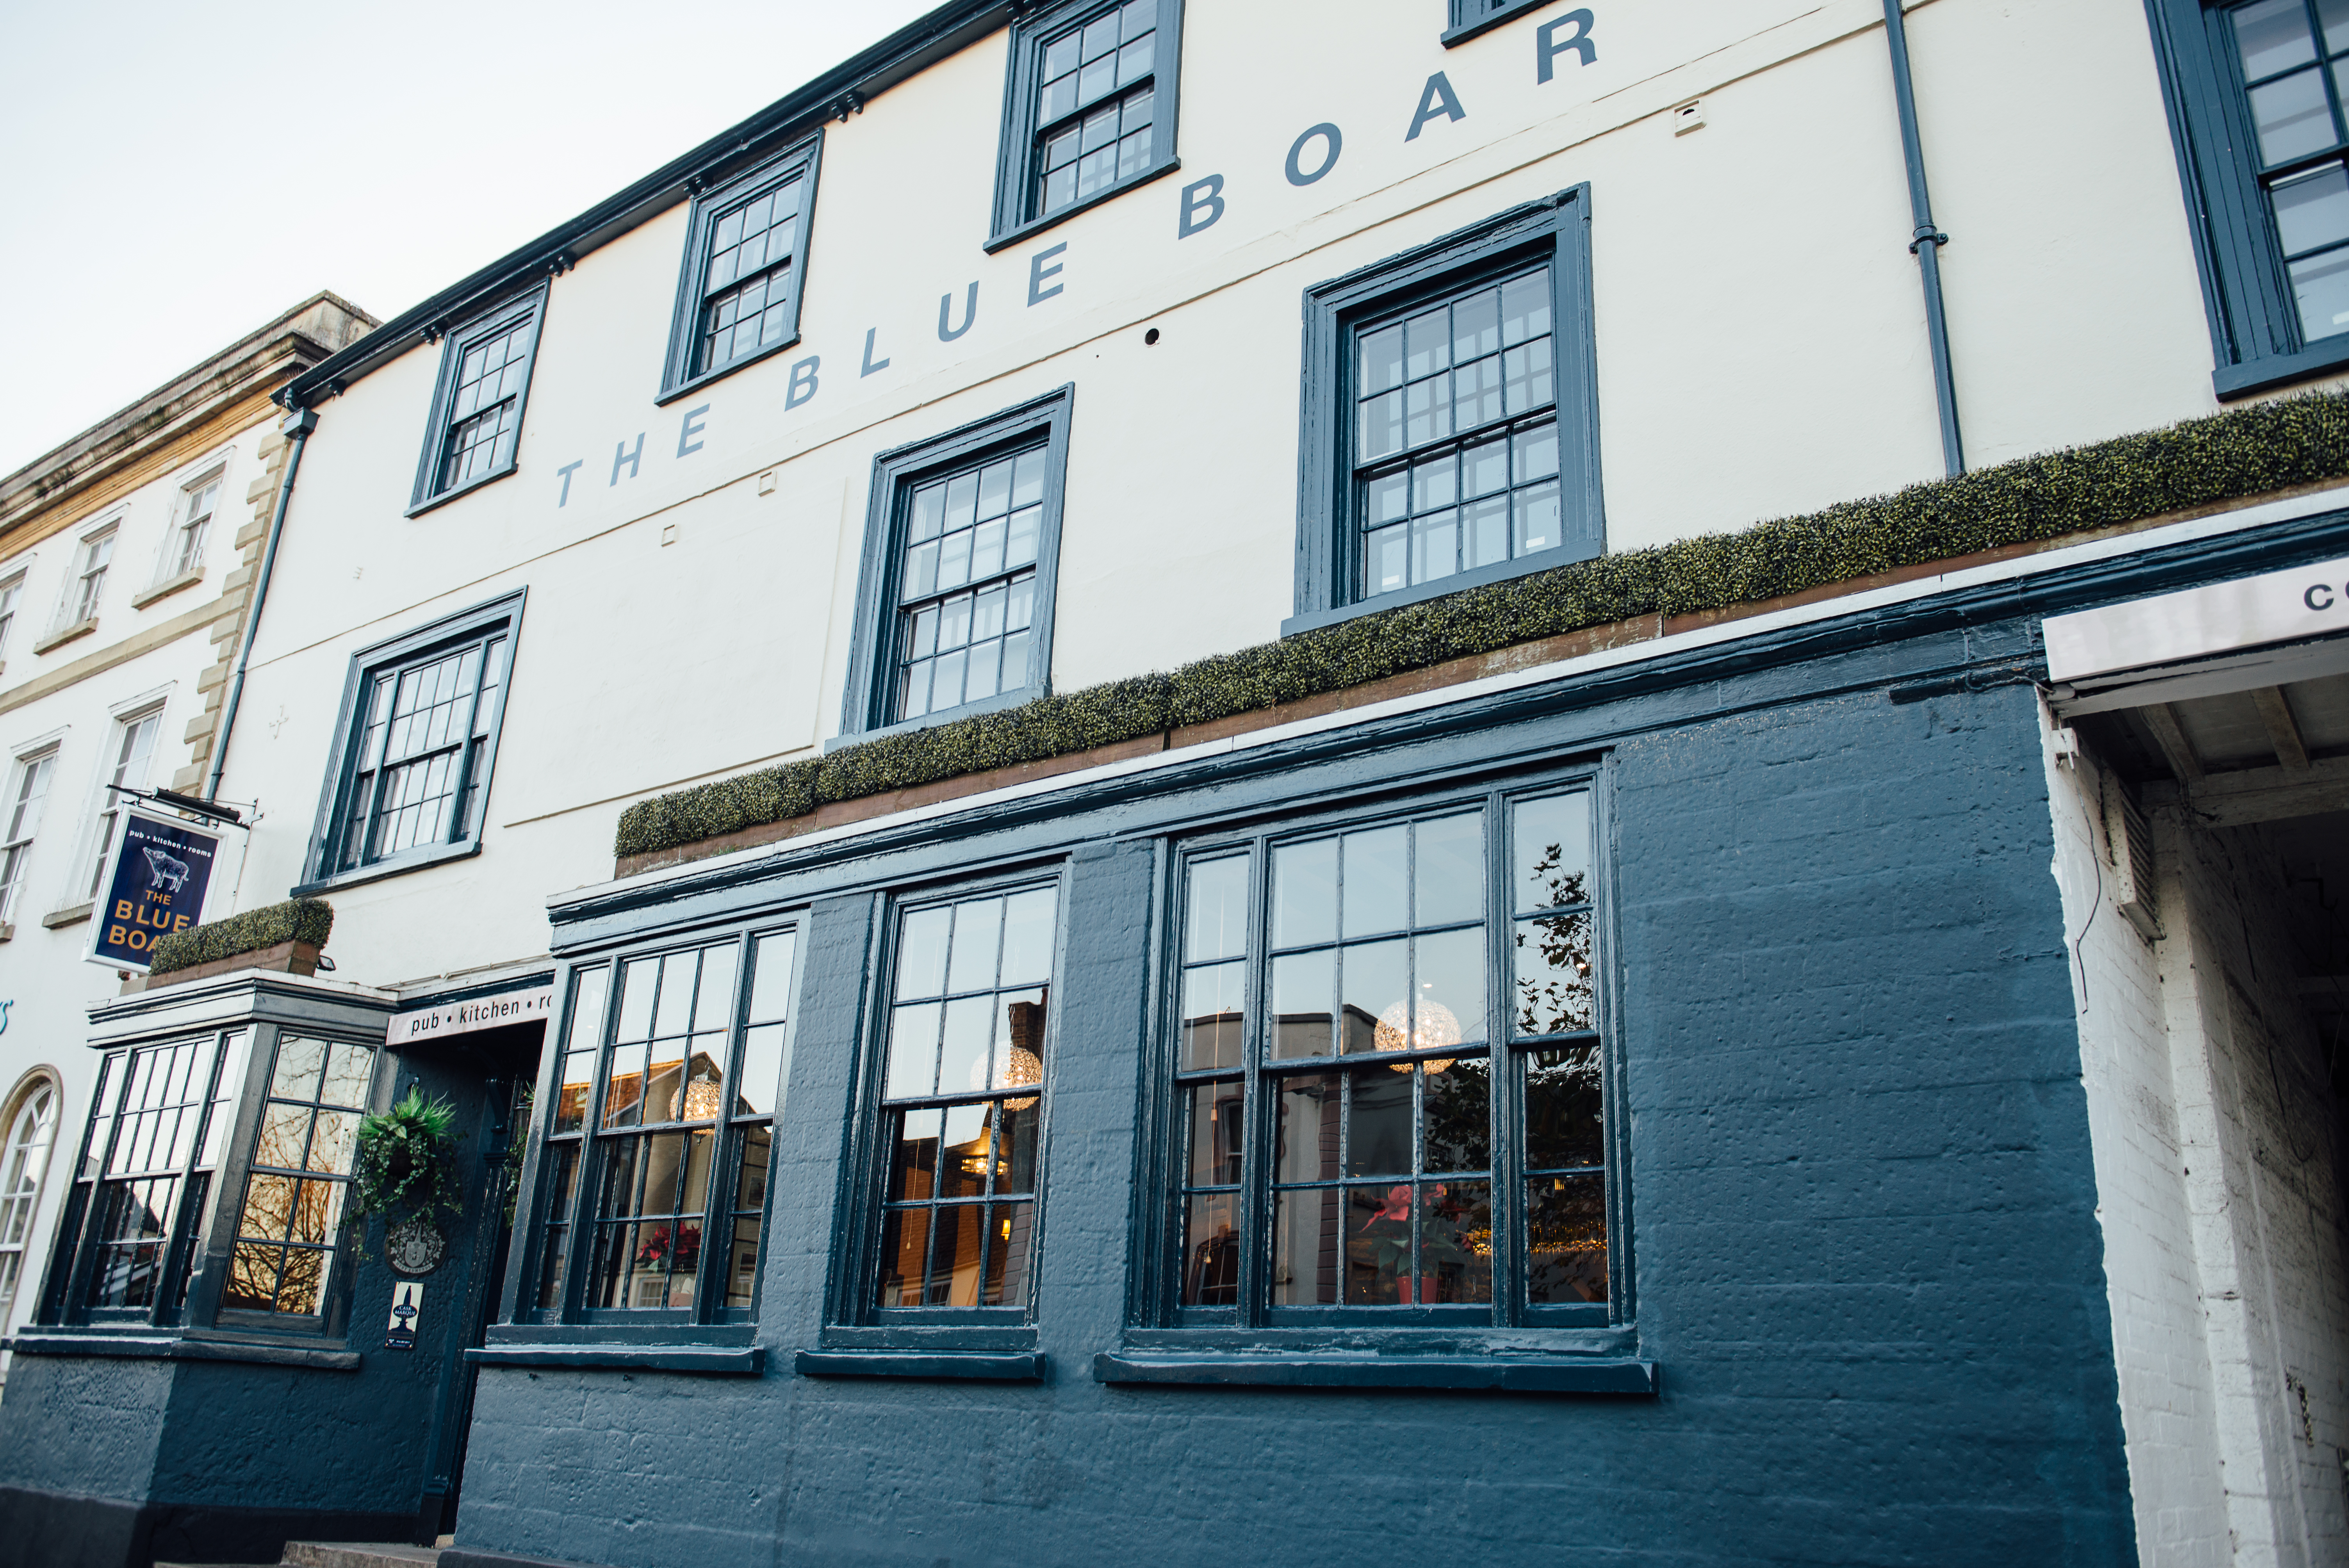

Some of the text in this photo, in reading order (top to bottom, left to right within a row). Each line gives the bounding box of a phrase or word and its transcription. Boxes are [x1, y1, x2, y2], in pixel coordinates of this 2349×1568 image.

[556, 8, 1598, 508] THE BLUE BOAR
[129, 830, 212, 857] pub kitchen rooms
[146, 890, 172, 905] THE
[115, 899, 190, 933] BLUE
[108, 924, 161, 952] BOA
[411, 1013, 439, 1036] pub
[459, 1000, 519, 1024] kitchen
